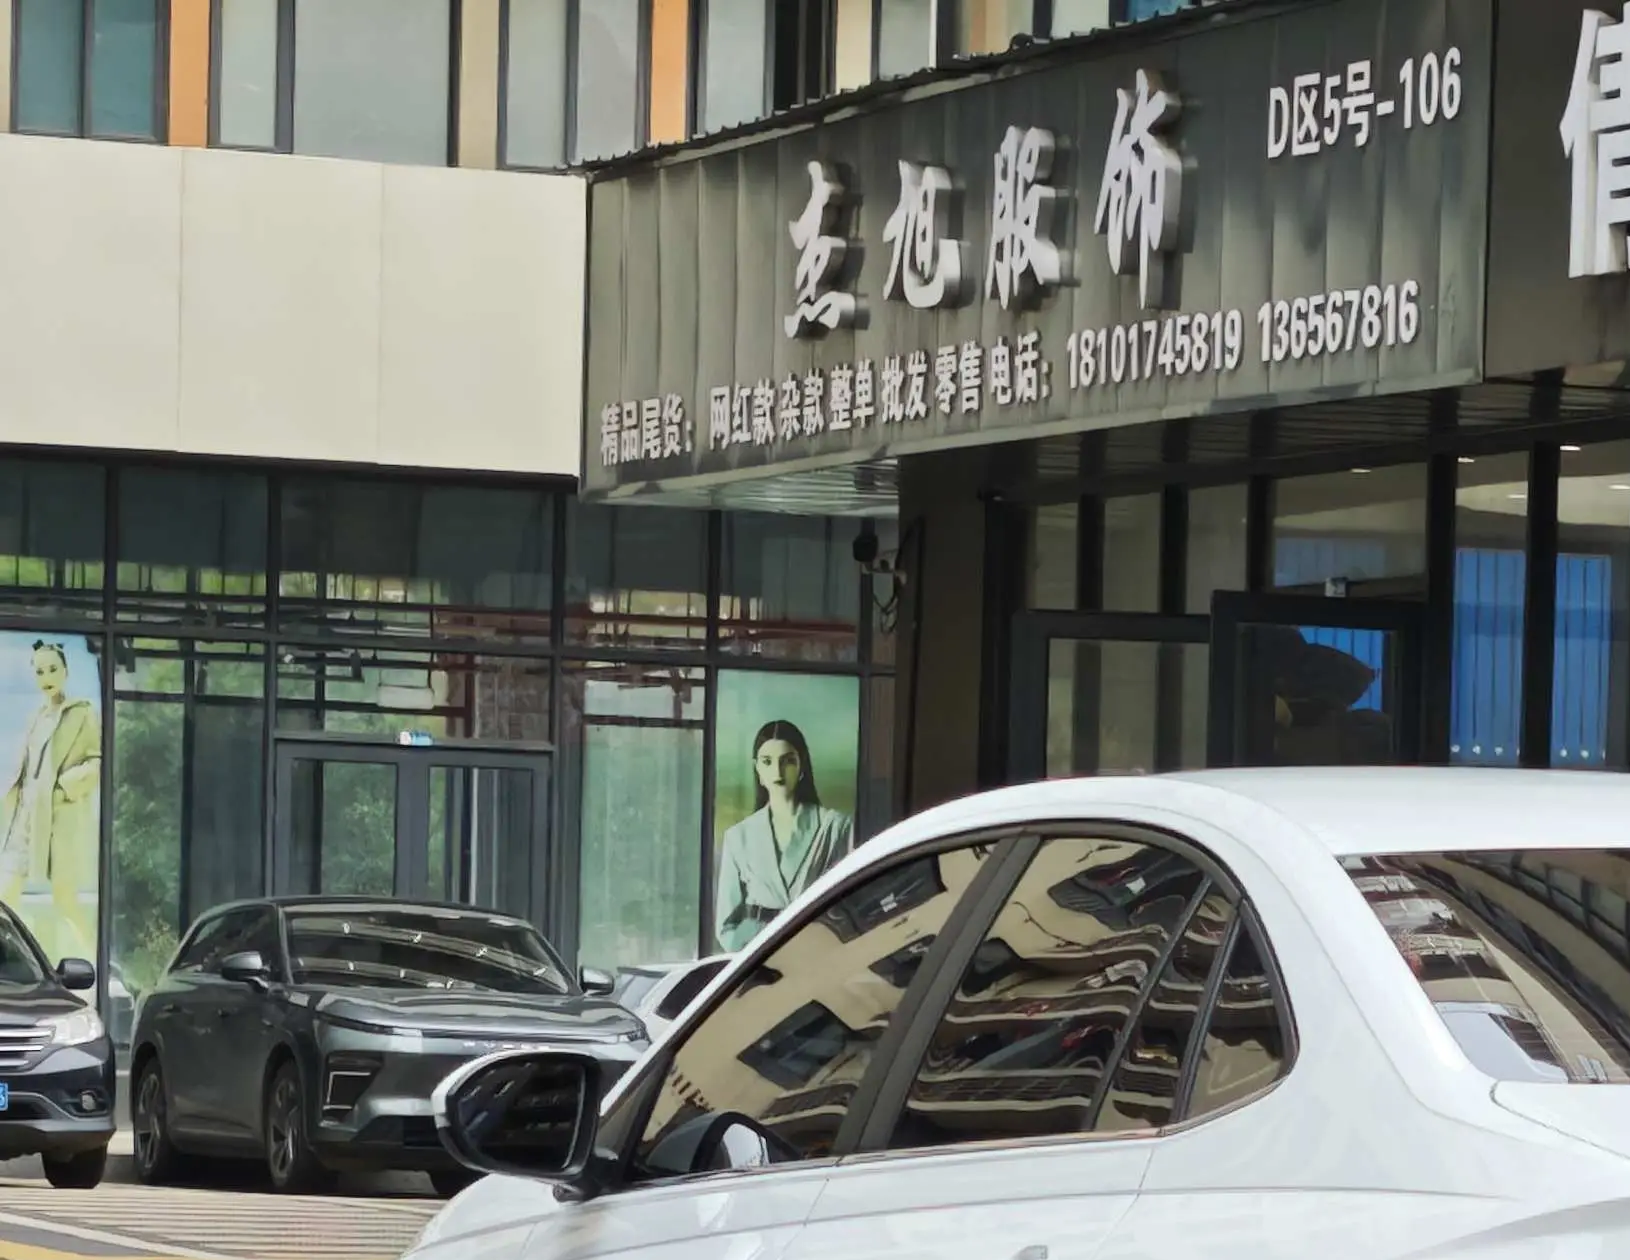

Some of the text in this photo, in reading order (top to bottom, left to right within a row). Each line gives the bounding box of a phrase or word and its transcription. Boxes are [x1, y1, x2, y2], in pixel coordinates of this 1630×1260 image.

[1267, 46, 1462, 159] D区5号-106
[709, 379, 776, 450] 网红款
[780, 367, 825, 441] 杂款
[829, 358, 876, 430] 整单
[881, 350, 928, 422] 批发
[935, 340, 983, 414] 零售
[1067, 309, 1243, 389] 18101745819
[1257, 279, 1420, 363] 136567816
